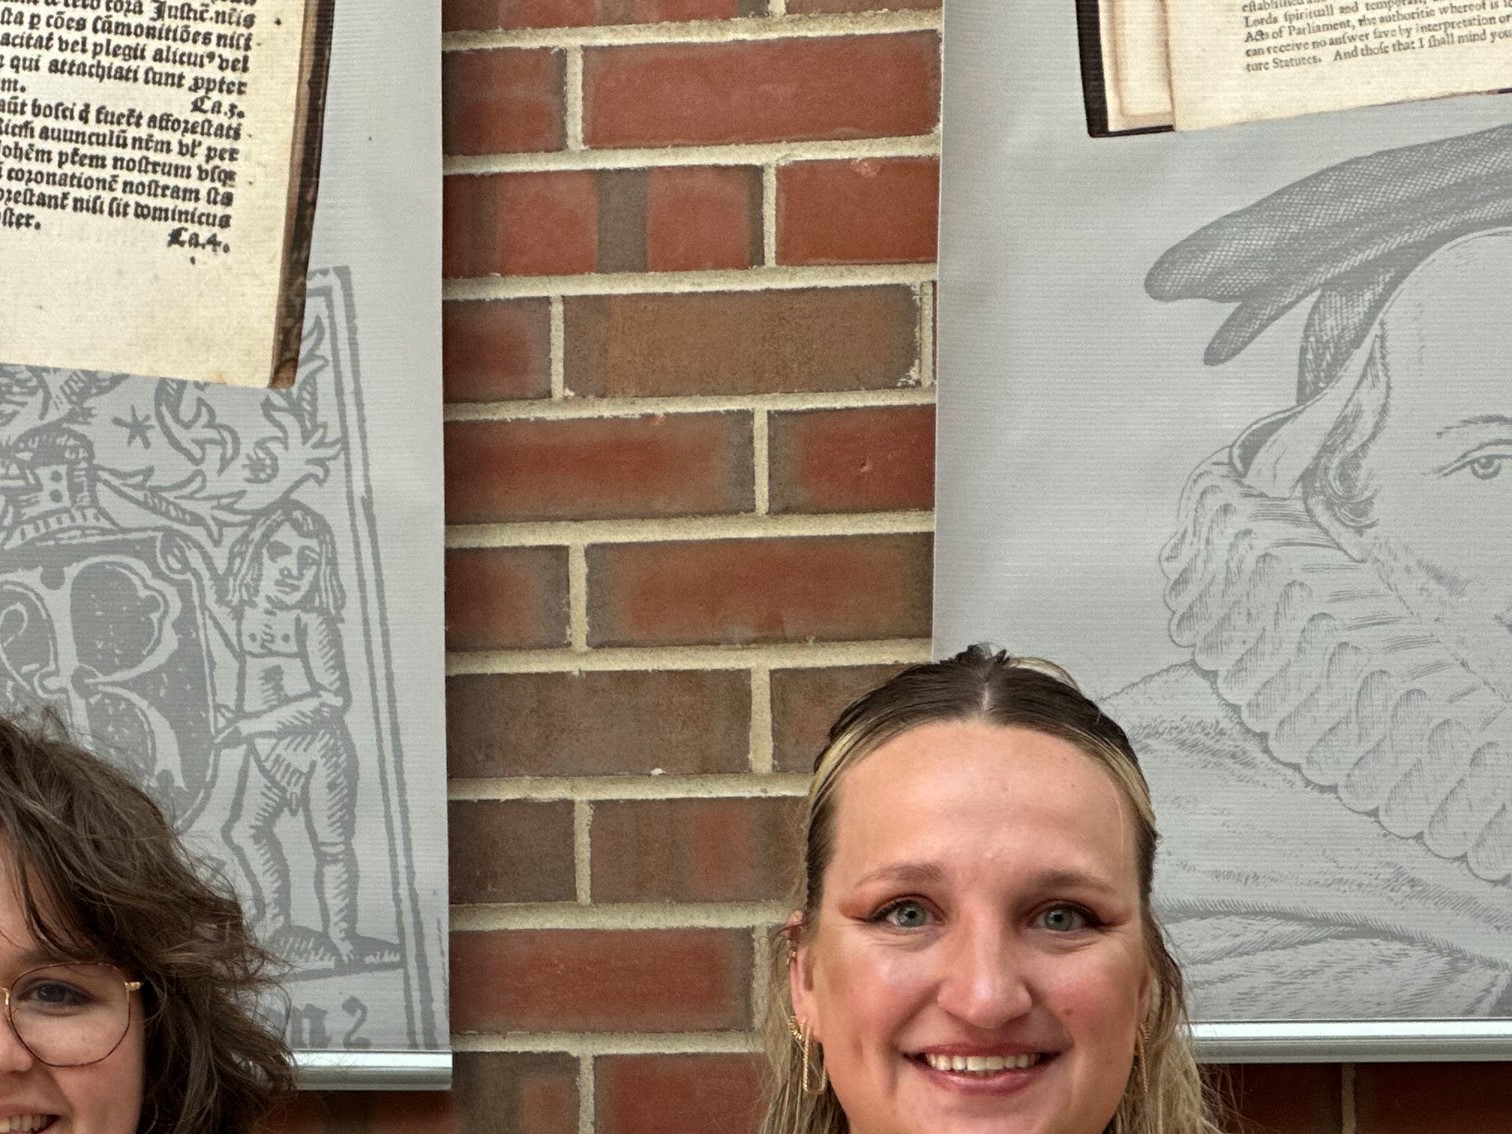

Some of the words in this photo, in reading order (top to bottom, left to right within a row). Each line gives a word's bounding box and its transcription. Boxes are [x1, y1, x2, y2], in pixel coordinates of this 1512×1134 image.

[1243, 13, 1278, 28] Lords
[1339, 1, 1359, 14] and
[1272, 26, 1285, 40] of
[1288, 19, 1356, 36] Parliament,
[1358, 15, 1377, 26] the
[1379, 7, 1436, 23] authoritie
[1438, 0, 1486, 15] whereof
[1245, 47, 1264, 57] can
[1266, 41, 1309, 54] receive
[1311, 39, 1327, 50] no
[1398, 24, 1413, 38] by
[1246, 61, 1270, 72] ture
[1334, 45, 1359, 61] And
[1457, 28, 1487, 44] mind
